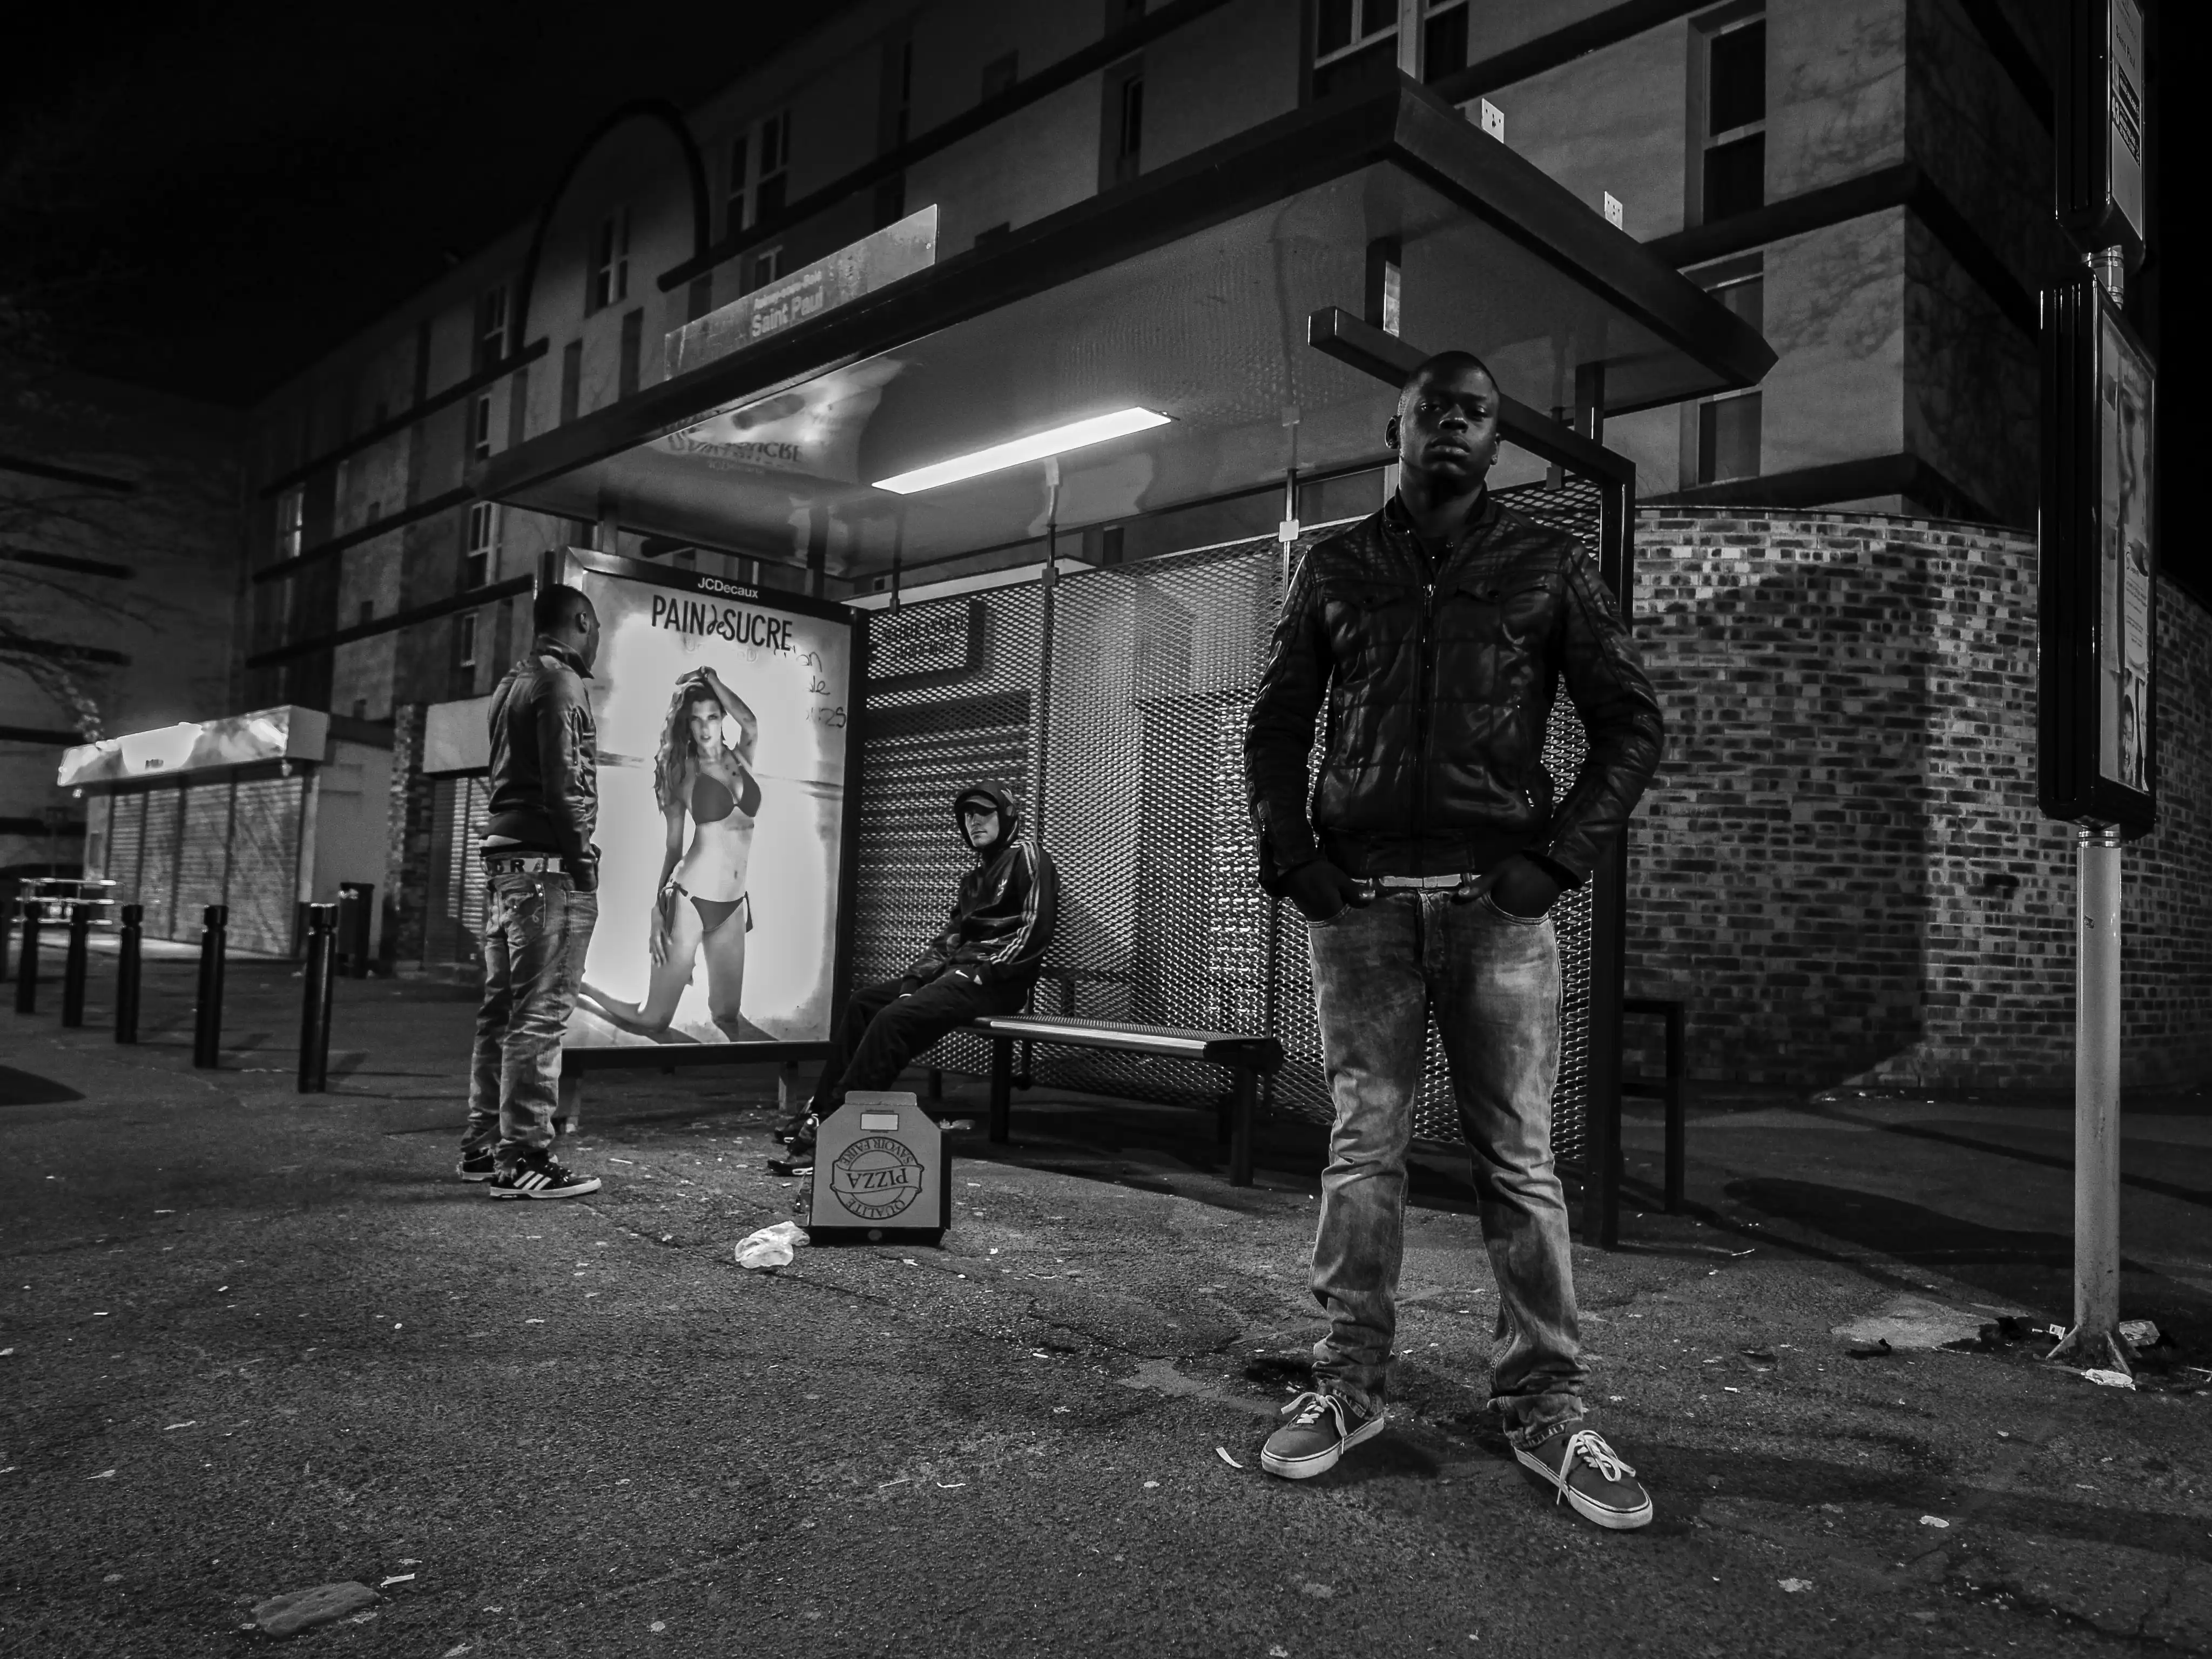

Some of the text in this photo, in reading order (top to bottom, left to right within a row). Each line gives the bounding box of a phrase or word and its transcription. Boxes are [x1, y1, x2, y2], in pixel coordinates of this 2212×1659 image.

[2112, 96, 2119, 125] 43
[752, 303, 788, 337] Saint
[791, 285, 824, 321] Paul
[698, 577, 759, 599] JCDecaux
[651, 594, 706, 636] PAIN
[706, 604, 725, 636] de
[723, 608, 793, 651] SUCRE
[841, 1138, 914, 1165] SAVOIR FAIRE
[845, 1168, 909, 1189] PIZZA
